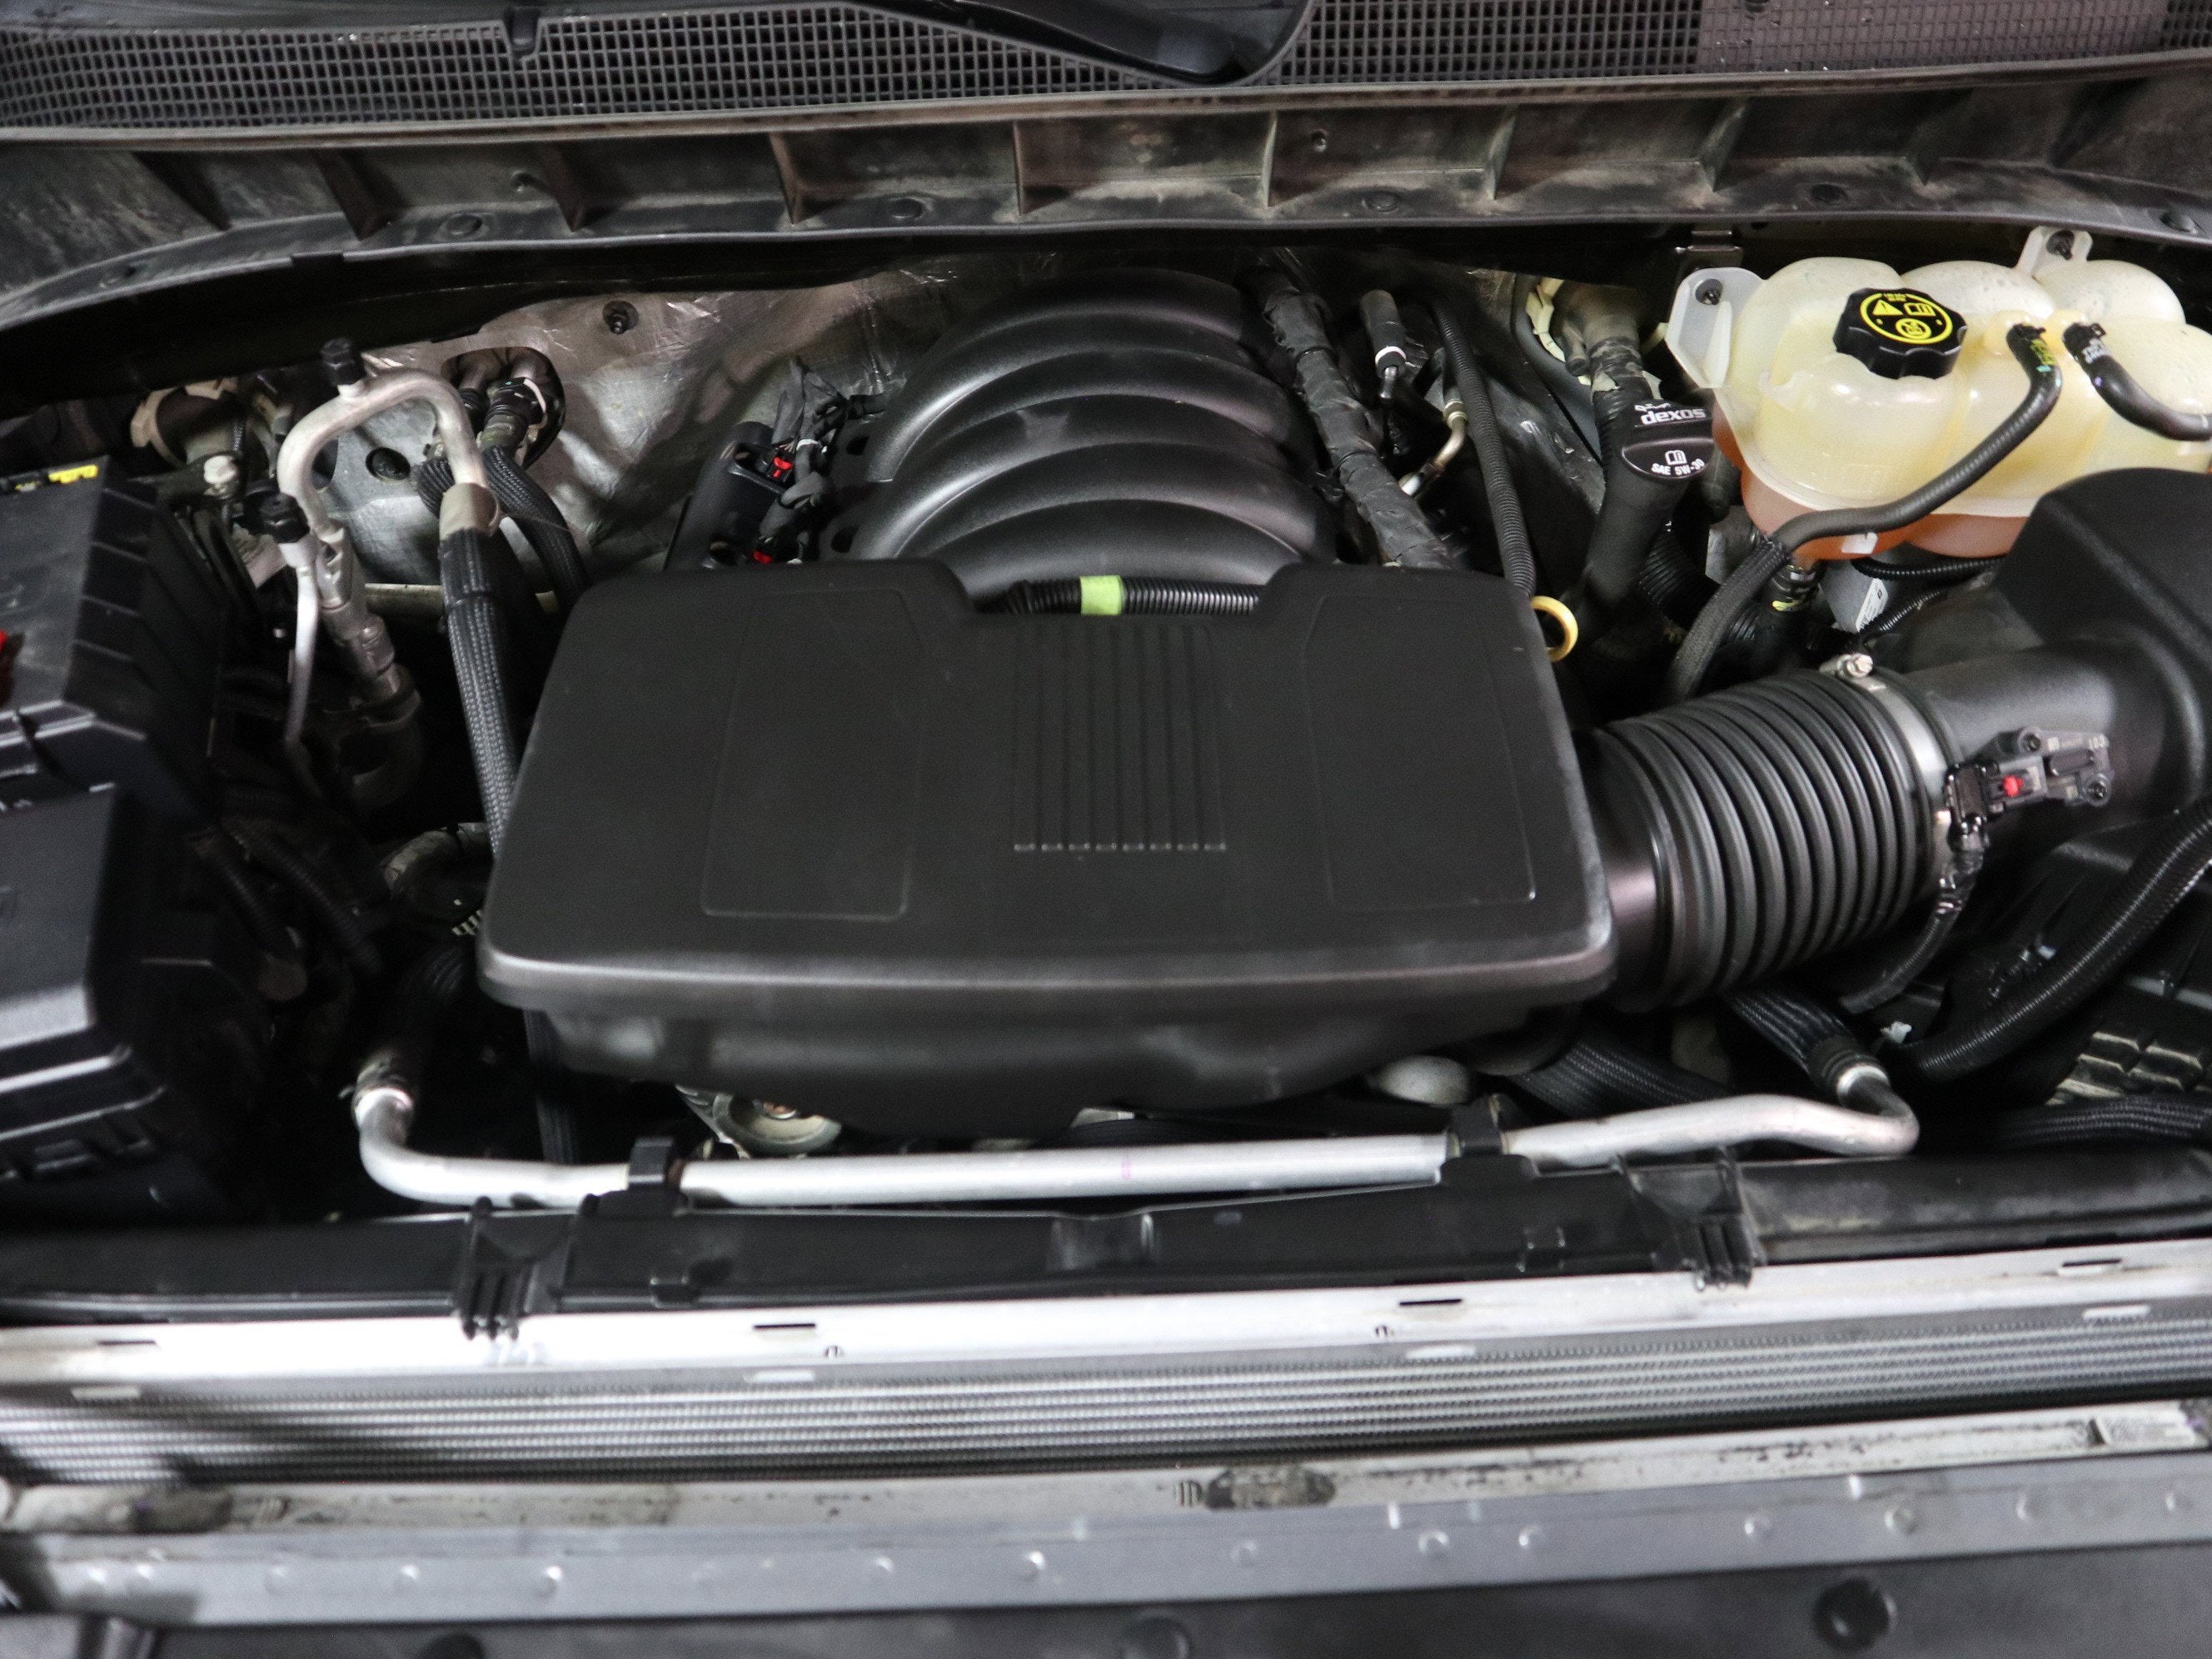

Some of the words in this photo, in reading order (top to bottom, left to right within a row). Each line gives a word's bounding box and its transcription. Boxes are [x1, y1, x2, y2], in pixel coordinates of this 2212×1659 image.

[1640, 408, 1706, 426] dexos
[1651, 463, 1671, 476] SAE
[1674, 458, 1706, 476] 5W-30
